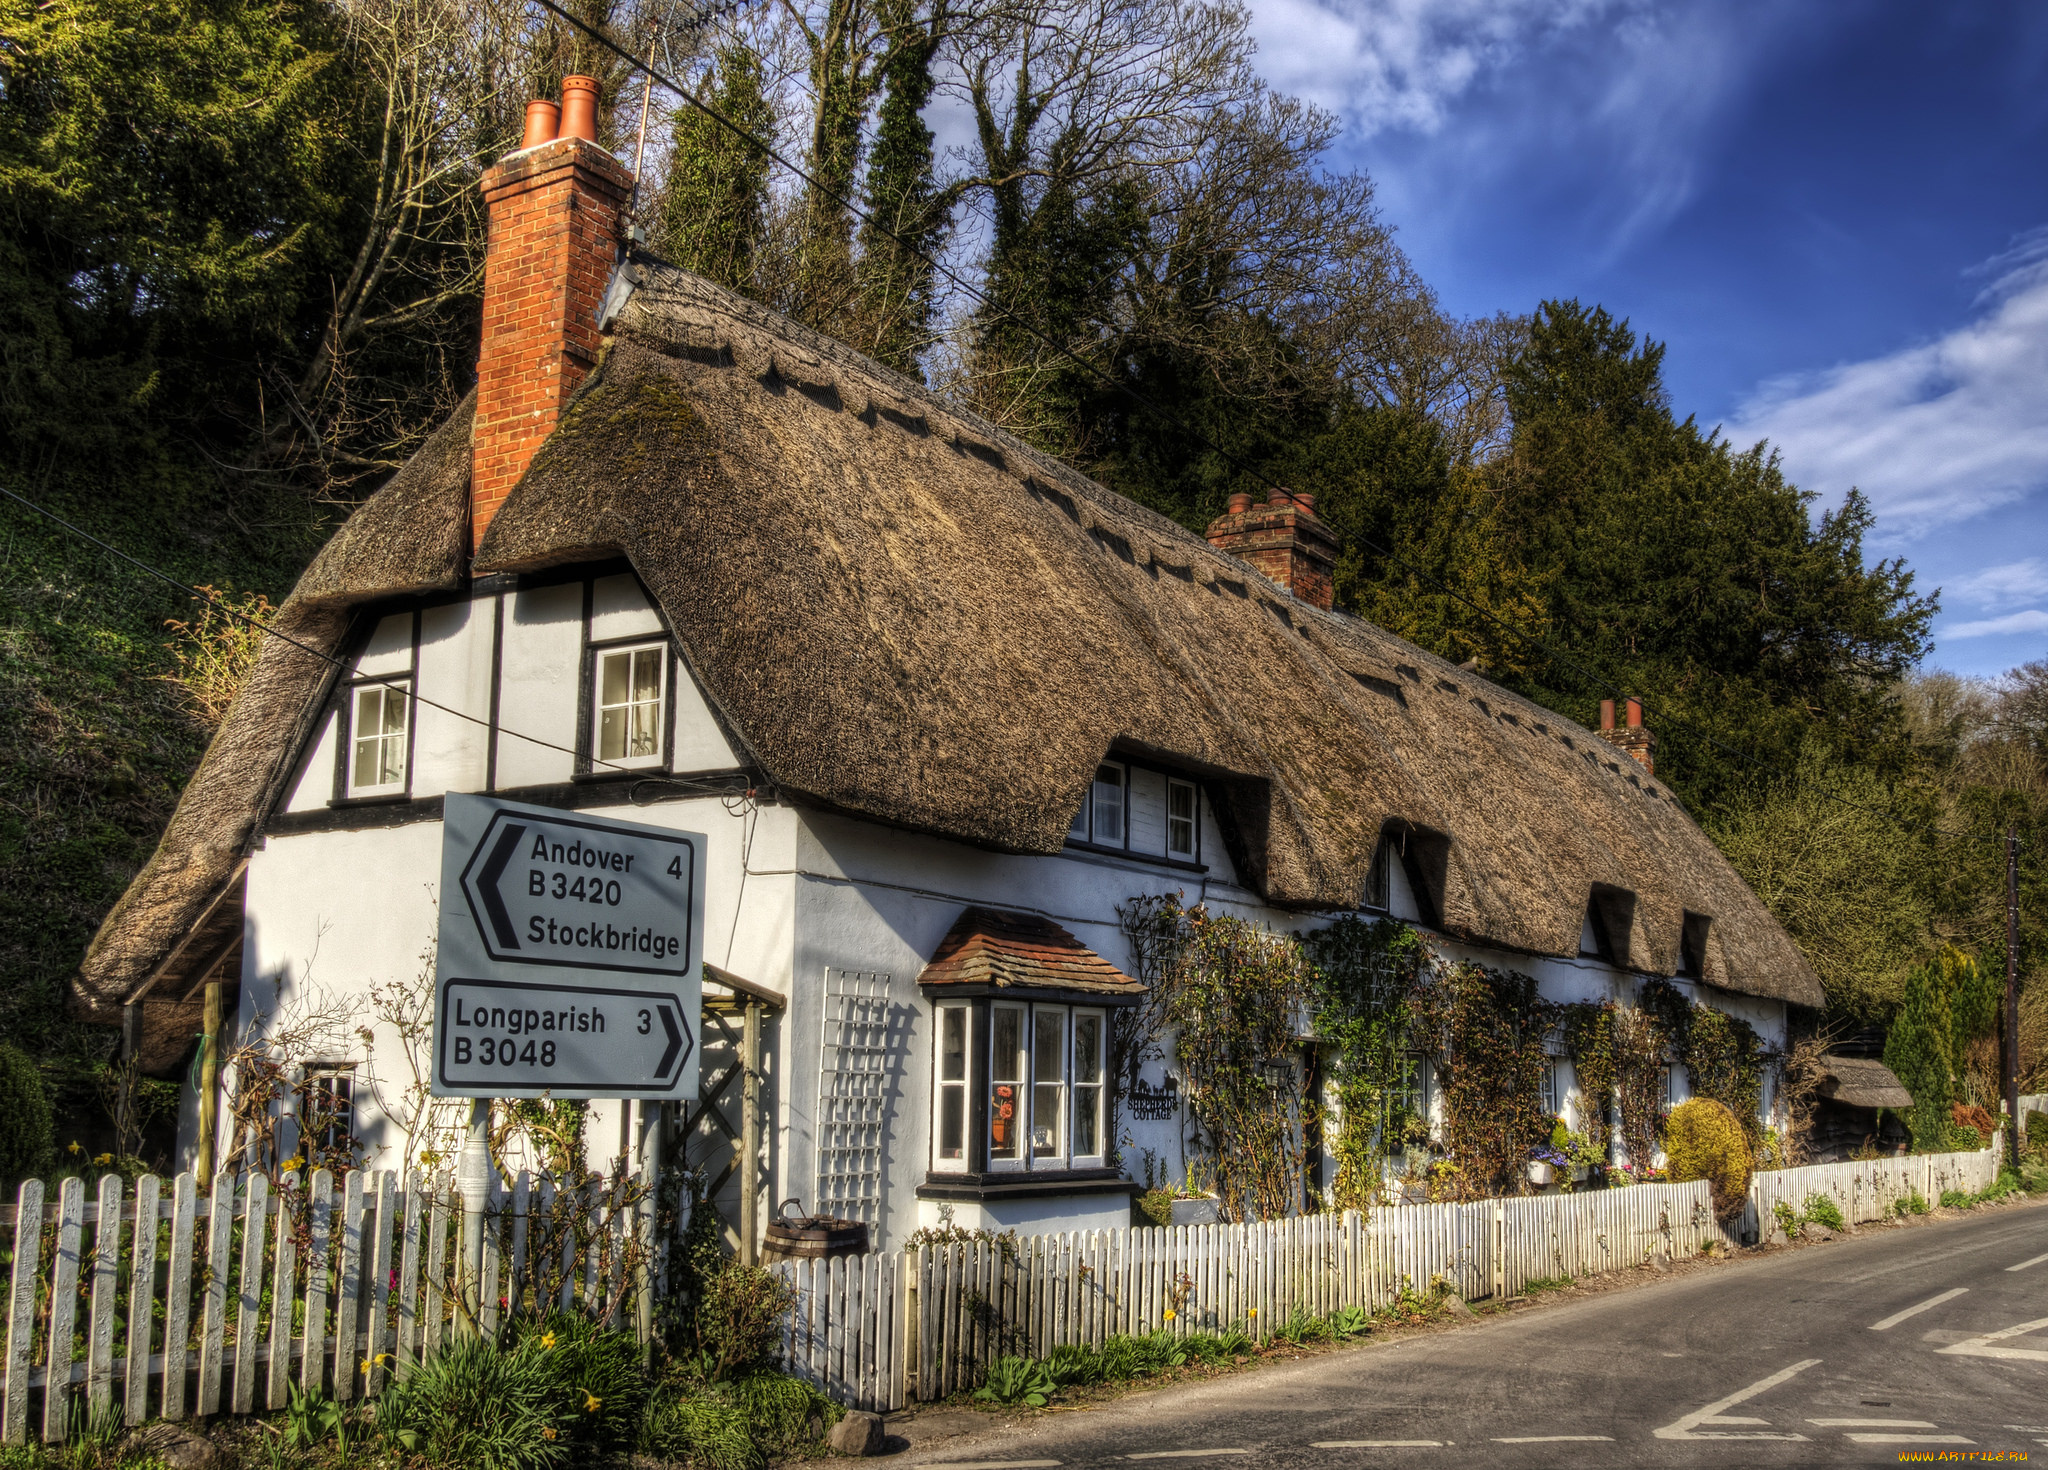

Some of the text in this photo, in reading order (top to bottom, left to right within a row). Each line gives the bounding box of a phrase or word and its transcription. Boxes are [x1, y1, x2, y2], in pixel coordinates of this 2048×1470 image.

[530, 834, 683, 880] Andover 4
[527, 915, 680, 959] Stockbridge
[456, 998, 652, 1035] Longparish 3
[1133, 1109, 1172, 1120] COTTAGE
